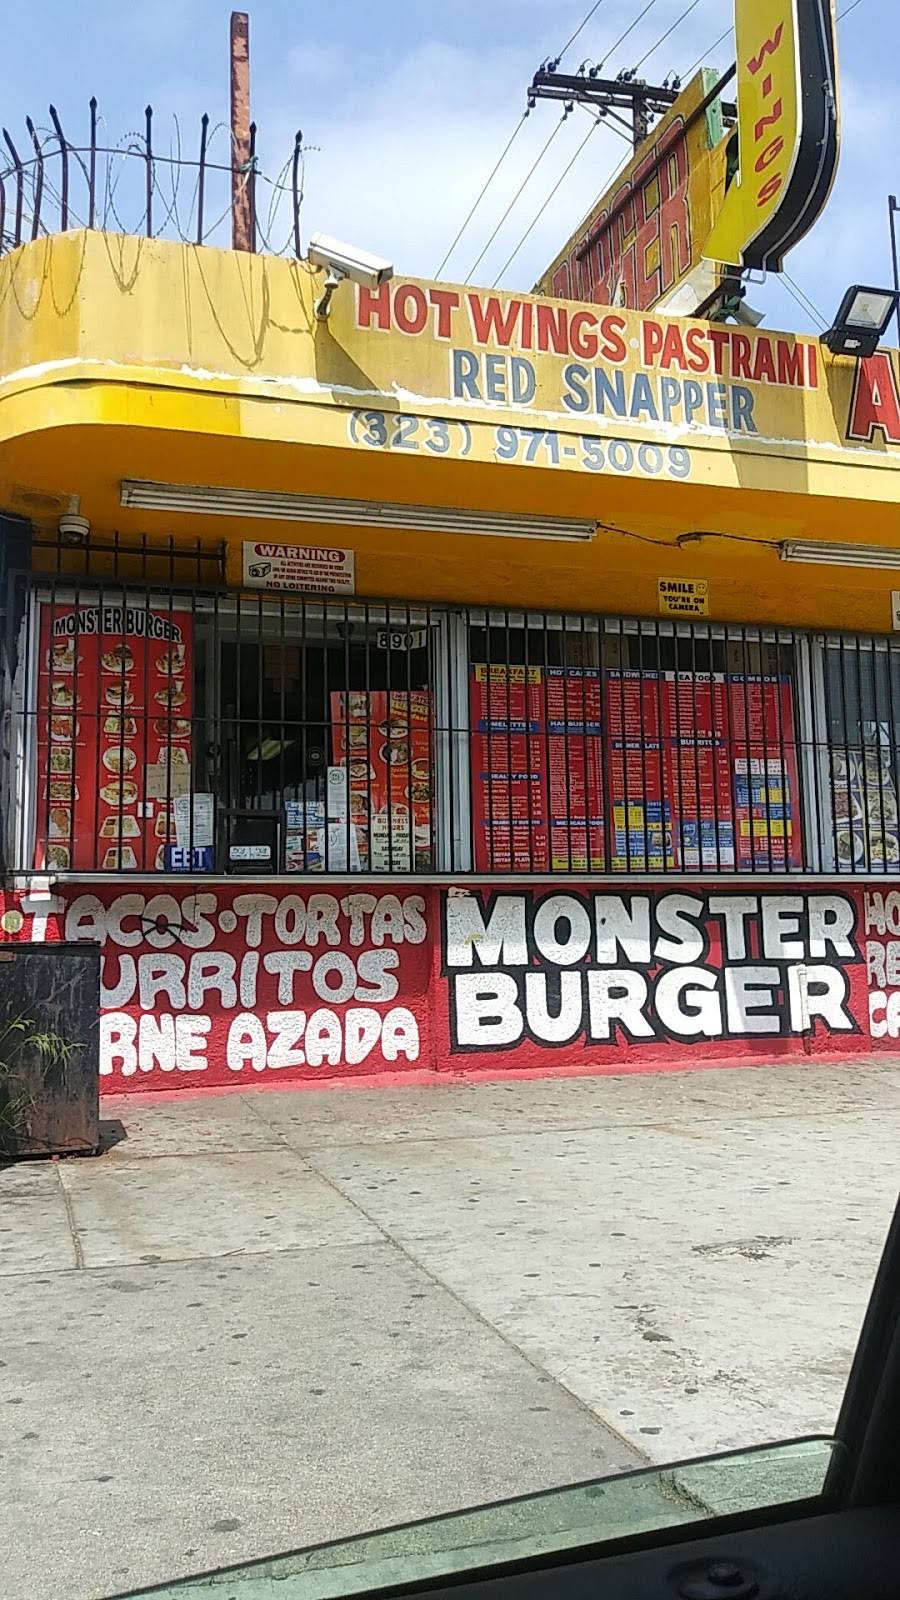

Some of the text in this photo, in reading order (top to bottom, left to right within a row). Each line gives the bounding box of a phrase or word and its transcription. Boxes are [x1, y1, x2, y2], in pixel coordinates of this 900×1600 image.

[746, 21, 785, 208] WINGS
[355, 282, 819, 388] HOT WINGS PASTRAMI
[451, 347, 758, 433] RED SNAPPER
[347, 409, 692, 480] (323) 971-5009
[259, 544, 341, 562] WARNING
[283, 582, 335, 593] LOITERING
[660, 582, 695, 593] SMILE
[668, 603, 700, 612] CAMERA
[54, 608, 183, 644] MONSTER BURGER
[379, 631, 424, 649] 8901
[609, 671, 660, 679] SADWIHES
[674, 674, 717, 682] EAOOD
[20, 893, 428, 948] TACOS TORTAS
[445, 893, 857, 968] MONSTER
[454, 963, 856, 1047] BURGER
[100, 1006, 421, 1077] RNE AZADA
